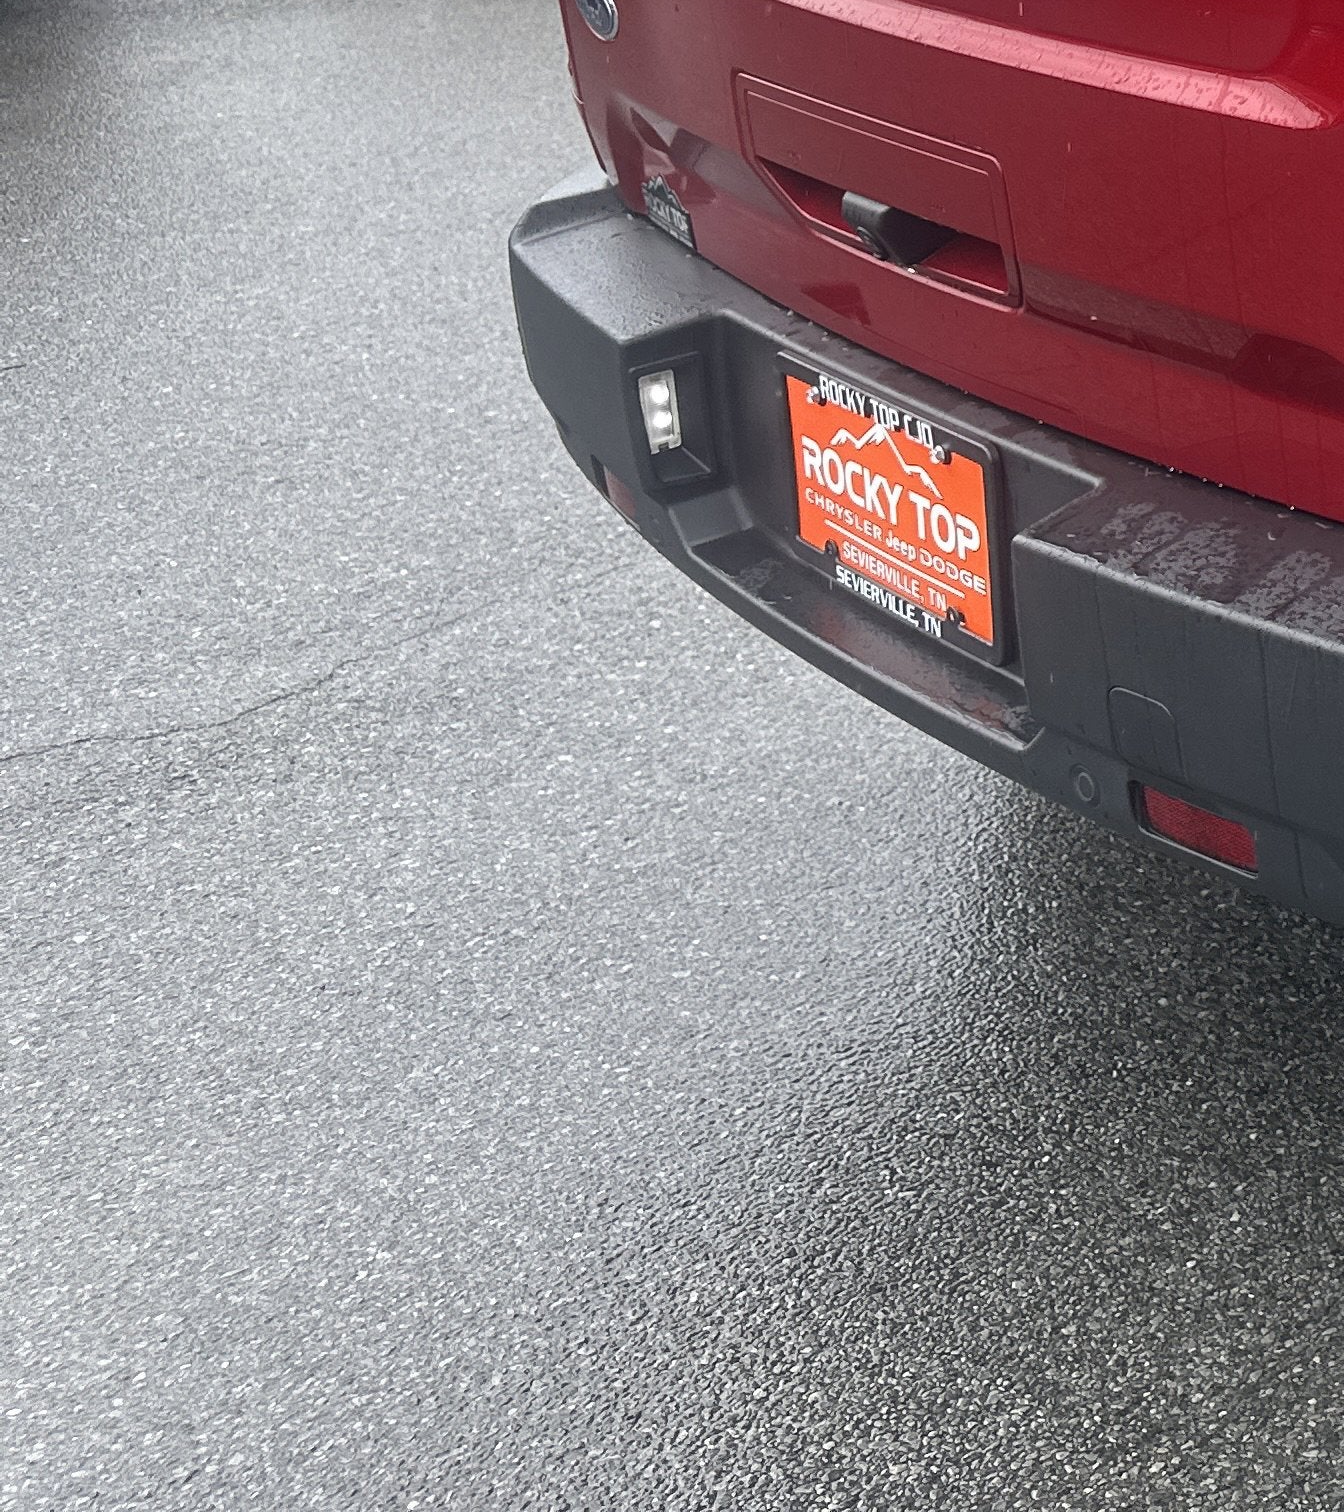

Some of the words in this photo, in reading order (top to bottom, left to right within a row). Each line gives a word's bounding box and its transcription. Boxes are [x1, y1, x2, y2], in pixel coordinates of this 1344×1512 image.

[819, 375, 867, 418] ROCKY
[869, 398, 900, 432] TOP
[903, 414, 934, 449] CJD
[802, 434, 904, 526] ROCKY
[908, 490, 981, 561] TOP
[805, 487, 883, 542] CHRYSLER
[885, 529, 917, 562] Jeep
[919, 547, 987, 595] DODGE
[843, 540, 925, 604] SEVIERVILLE,
[927, 587, 948, 612] TN
[835, 564, 920, 628] SEVIERVILLE,
[921, 611, 942, 638] TN
